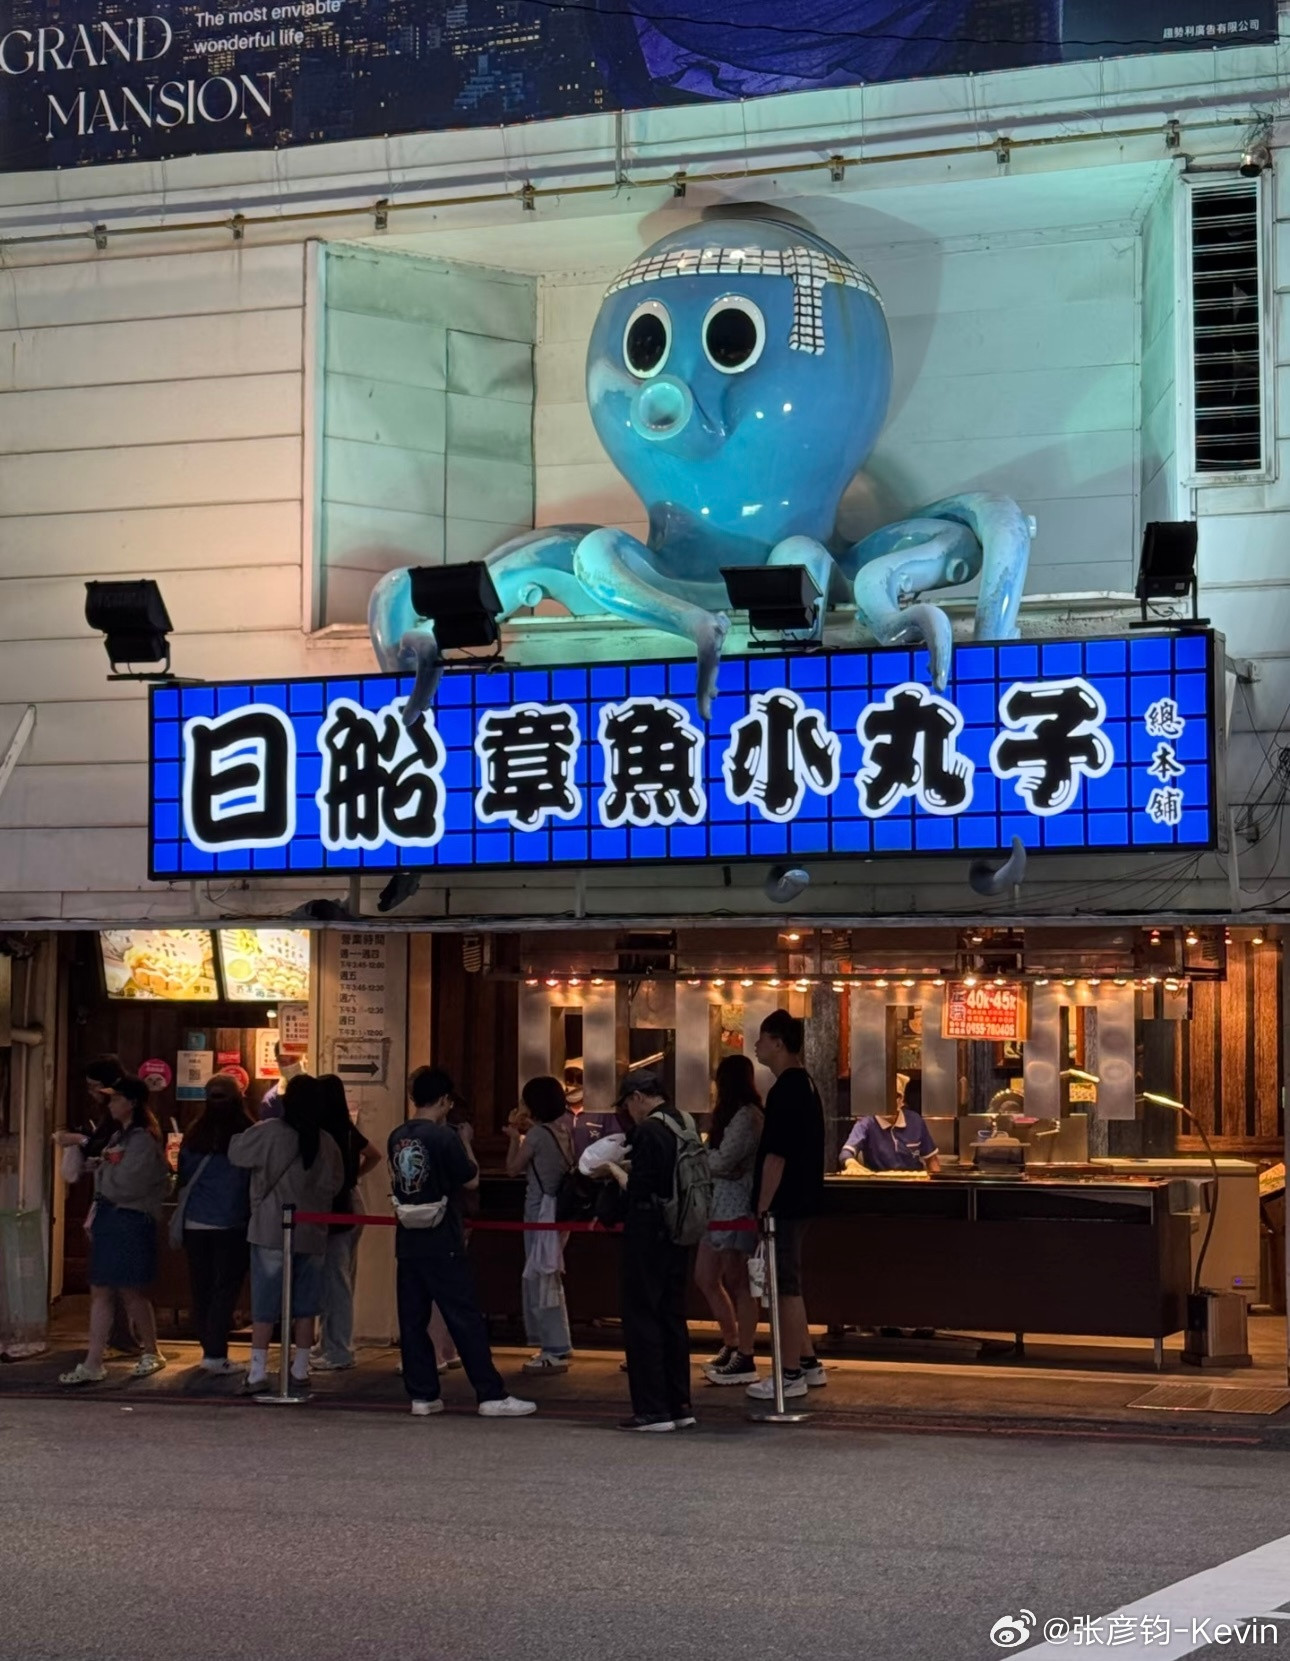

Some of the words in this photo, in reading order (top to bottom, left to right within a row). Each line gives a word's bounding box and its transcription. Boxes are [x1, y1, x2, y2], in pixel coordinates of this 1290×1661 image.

[193, 31, 276, 54] wonderful
[279, 28, 305, 45] life
[194, 12, 225, 28] The
[229, 6, 268, 24] most
[271, 0, 342, 20] enviable
[0, 15, 173, 75] GRAND
[46, 72, 277, 139] MANSION
[183, 677, 1114, 852] 日船章魚小丸子
